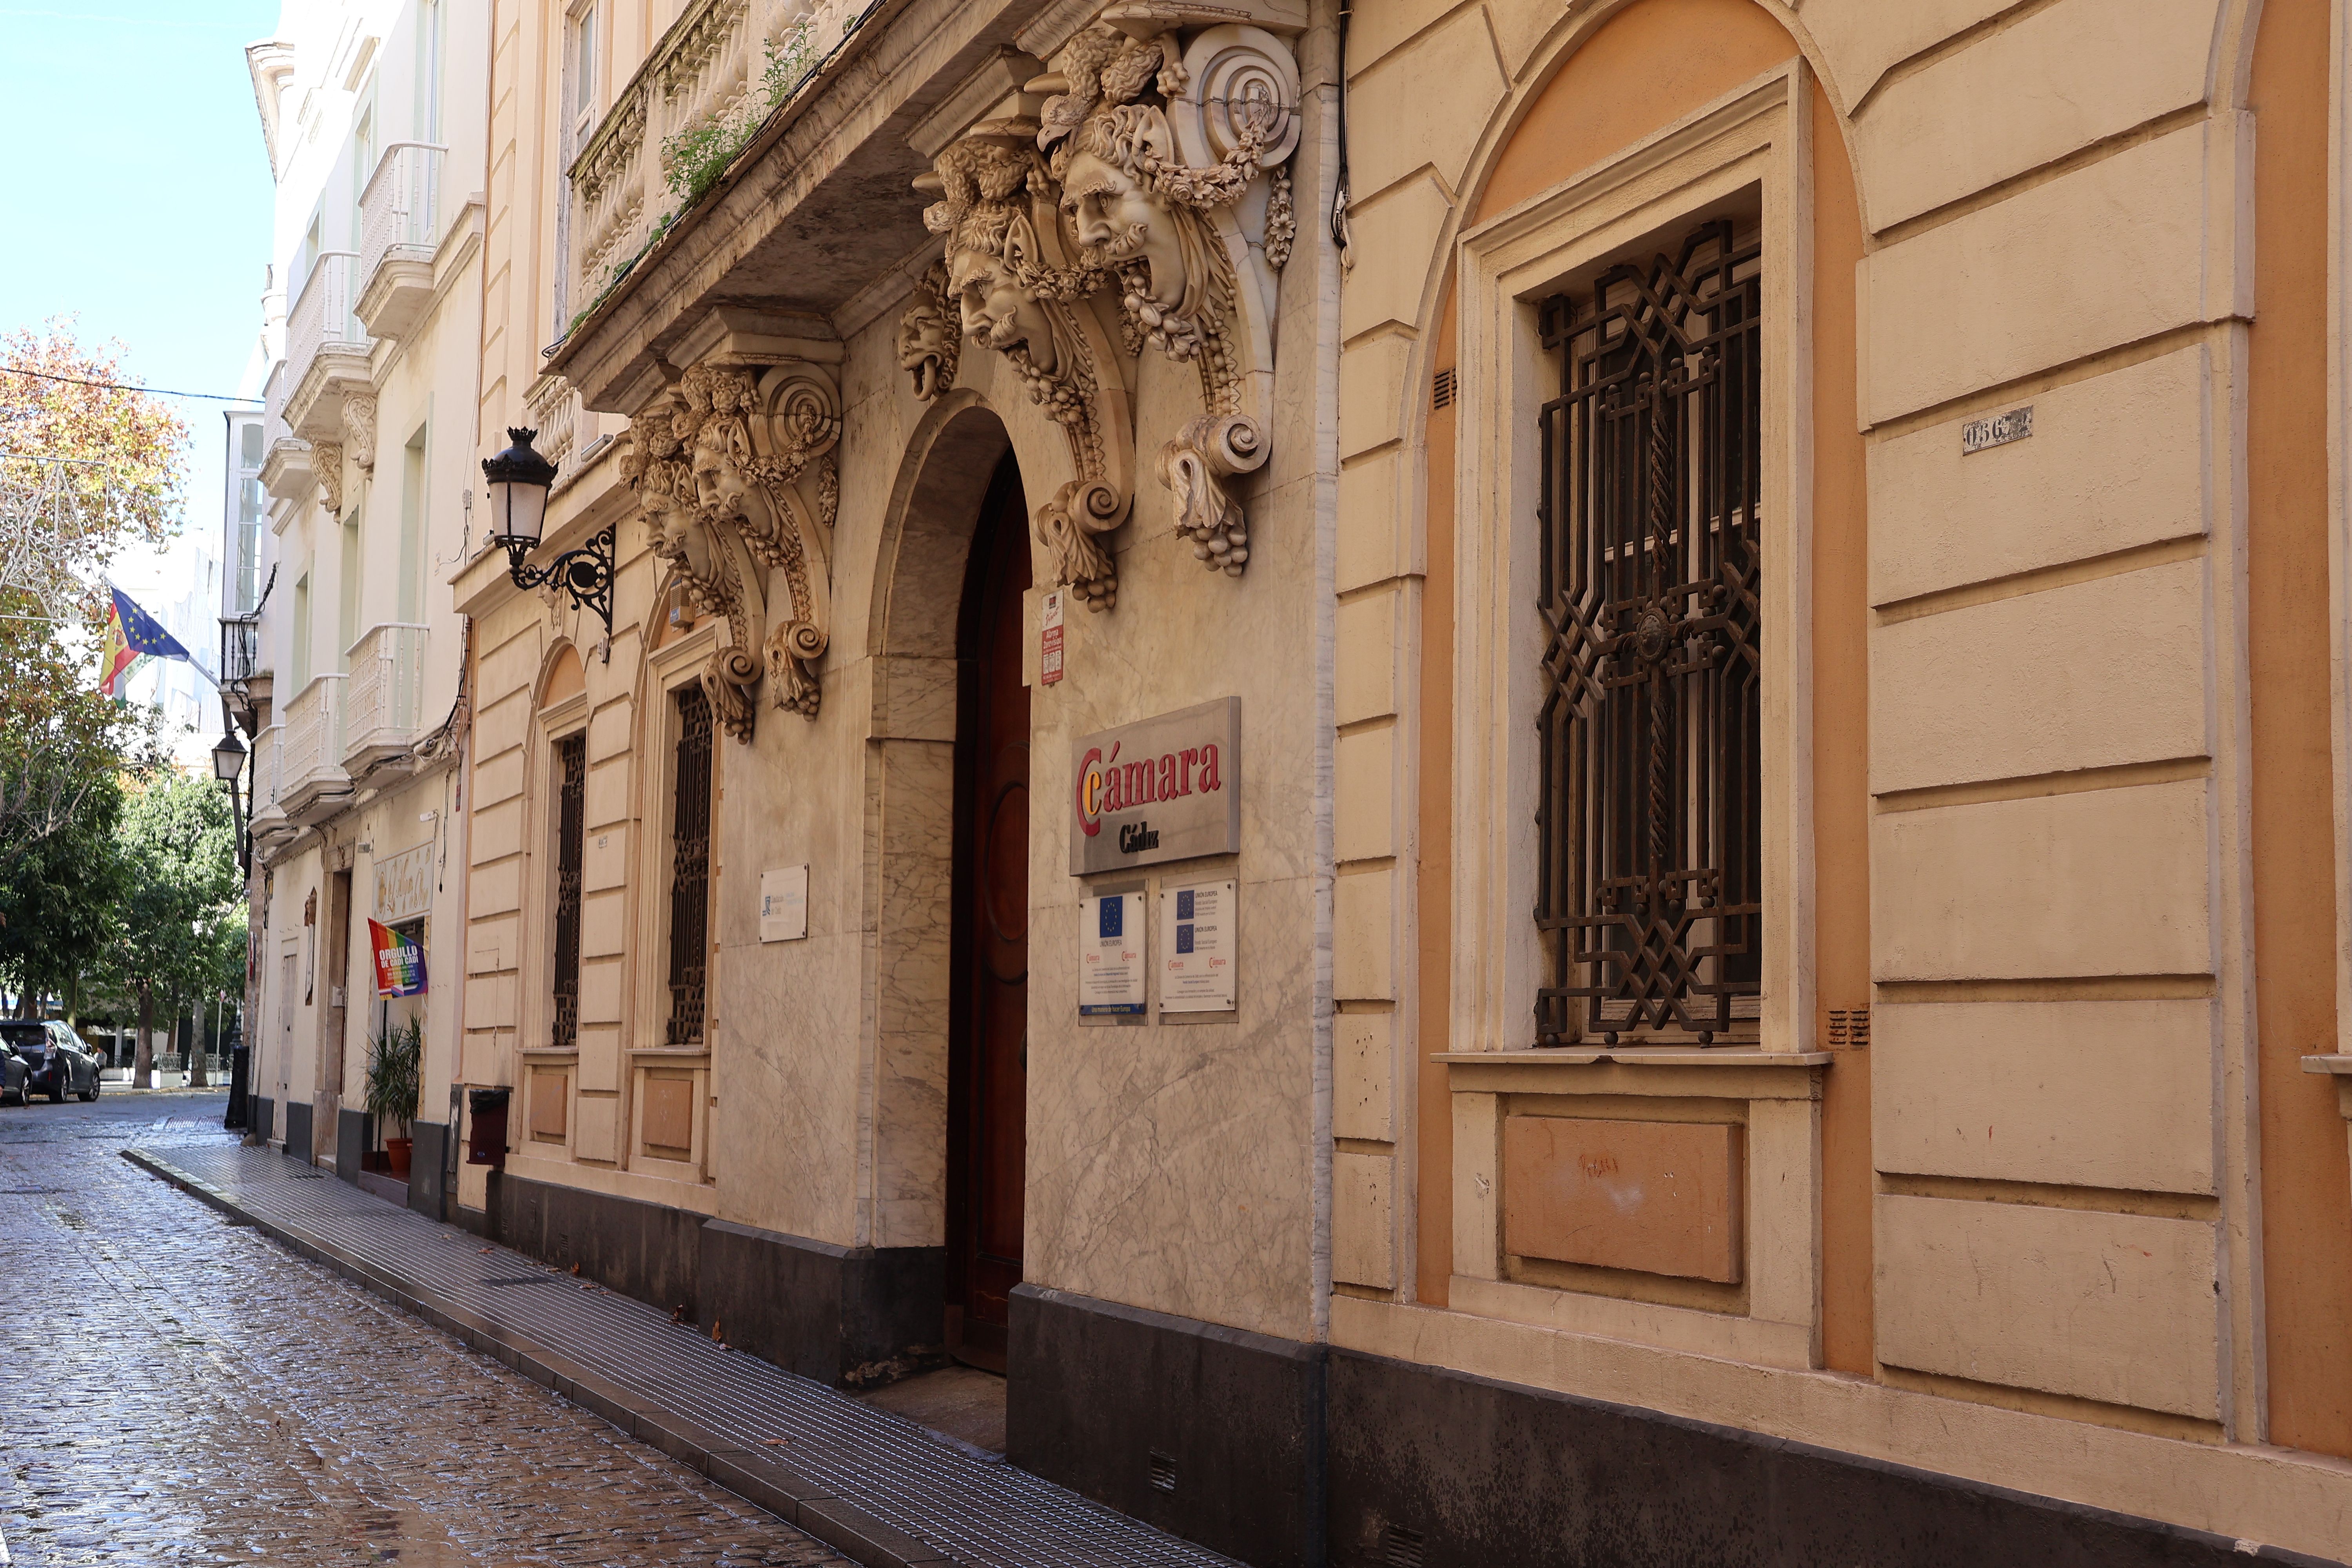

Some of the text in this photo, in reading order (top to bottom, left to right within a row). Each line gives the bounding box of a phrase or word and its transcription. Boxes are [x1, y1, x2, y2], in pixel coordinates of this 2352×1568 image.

[1076, 740, 1221, 837] Cámara
[1119, 821, 1159, 854] Cádiz
[379, 945, 418, 960] ORGULLO
[381, 960, 389, 969] DE
